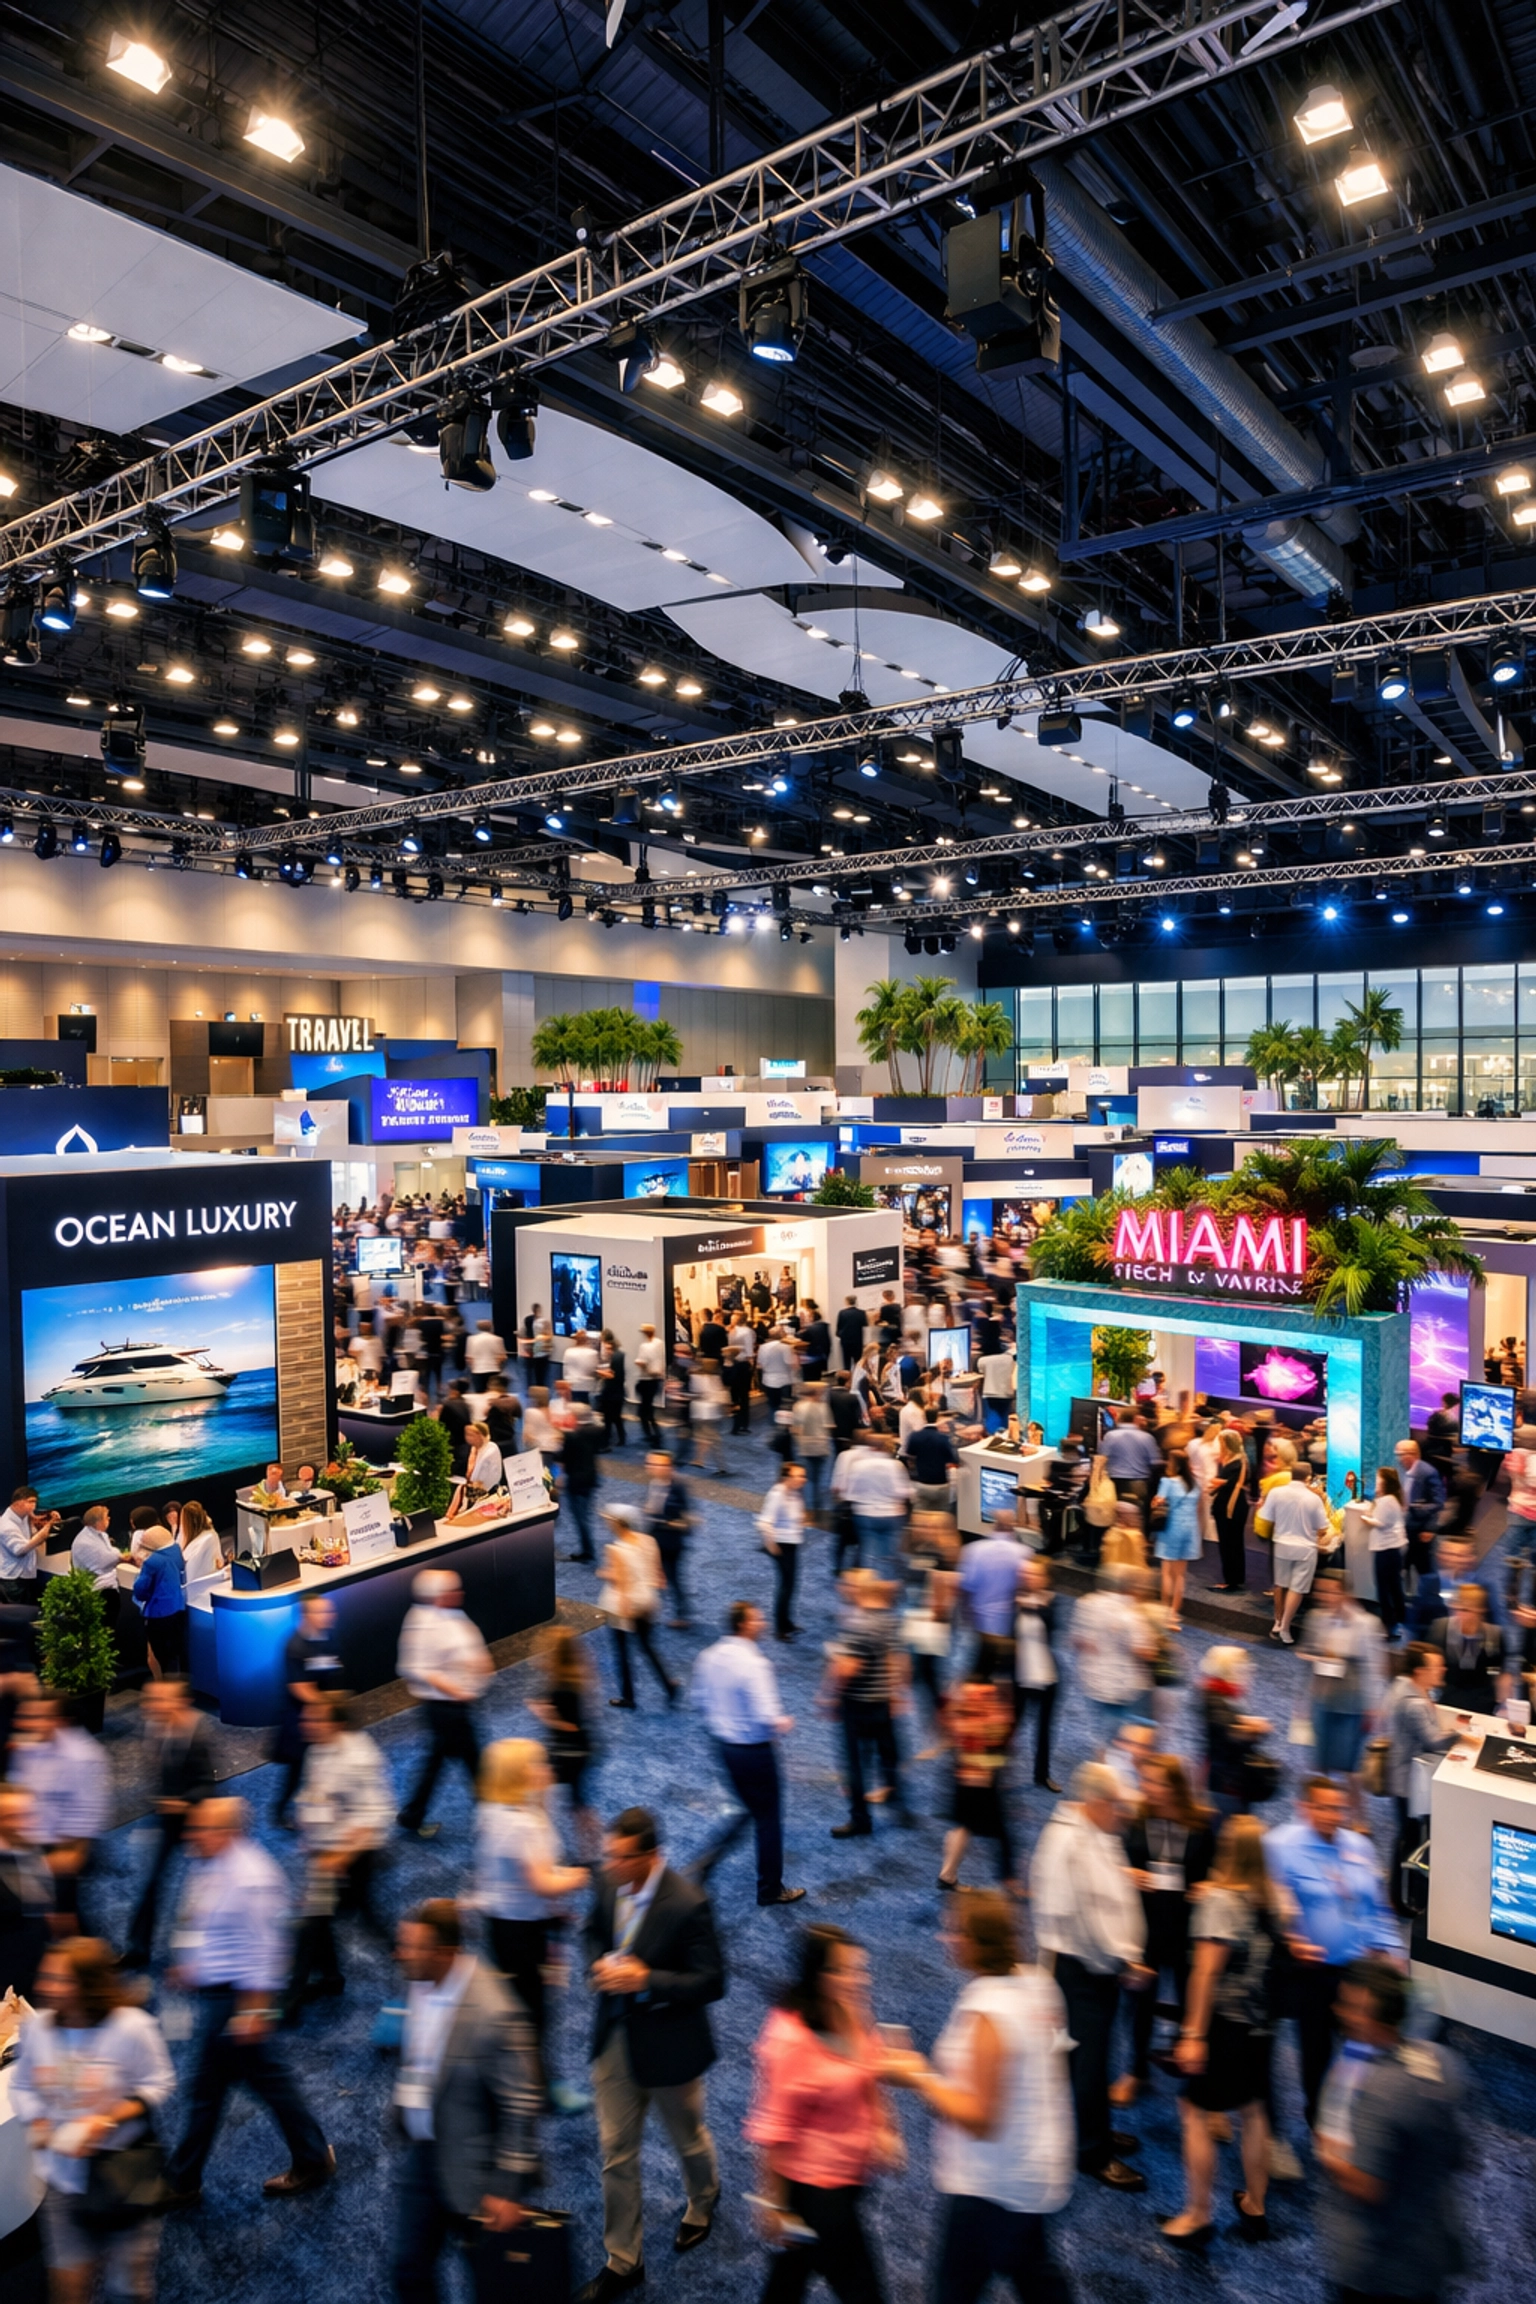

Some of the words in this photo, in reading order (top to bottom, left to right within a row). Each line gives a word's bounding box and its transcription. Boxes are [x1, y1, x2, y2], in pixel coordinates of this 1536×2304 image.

[54, 1210, 176, 1247] OCEAN
[186, 1200, 298, 1236] LUXURY
[1114, 1208, 1307, 1274] MIAMI
